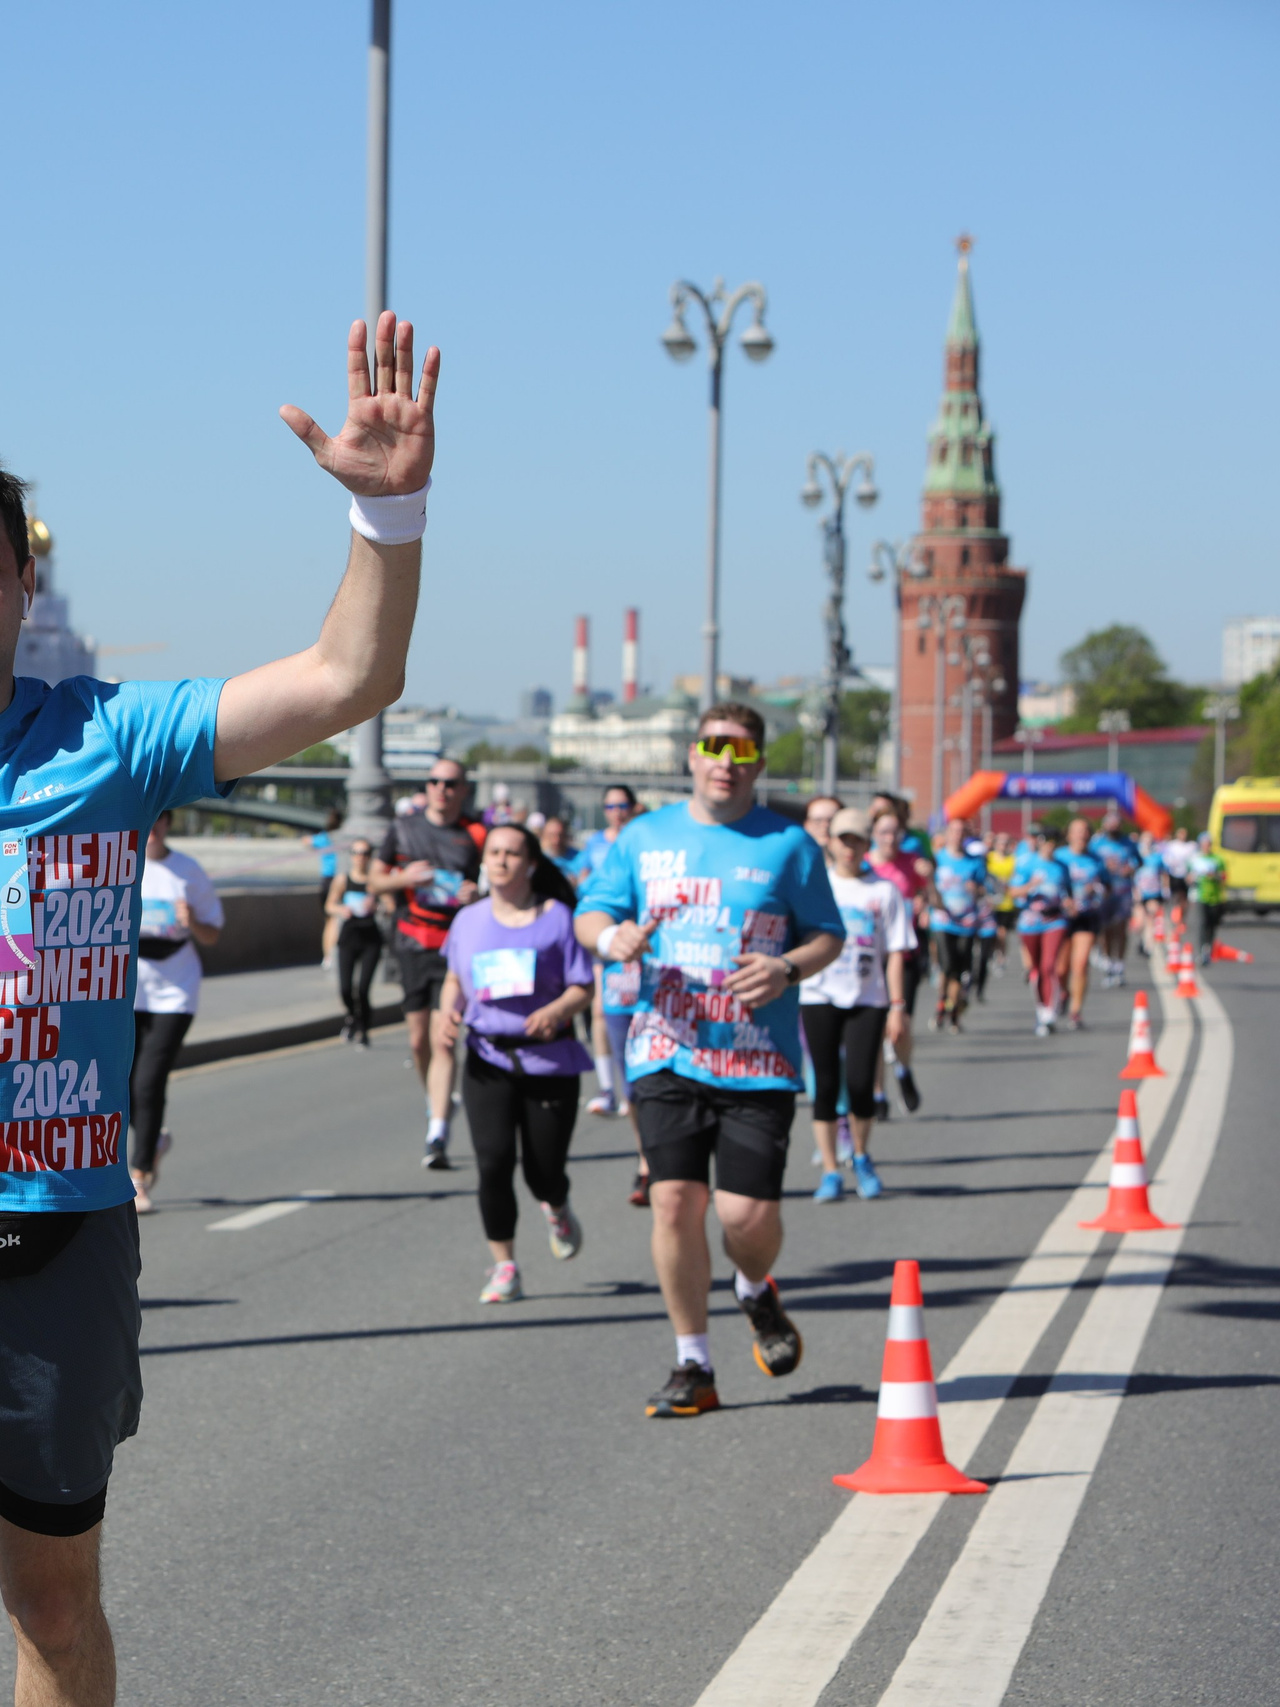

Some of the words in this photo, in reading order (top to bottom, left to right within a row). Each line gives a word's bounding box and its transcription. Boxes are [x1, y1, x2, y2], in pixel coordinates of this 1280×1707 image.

[27, 830, 138, 890] #ЦЕЛЬ
[6, 887, 22, 905] D
[45, 887, 132, 947] 2024
[12, 1058, 102, 1119] 2024
